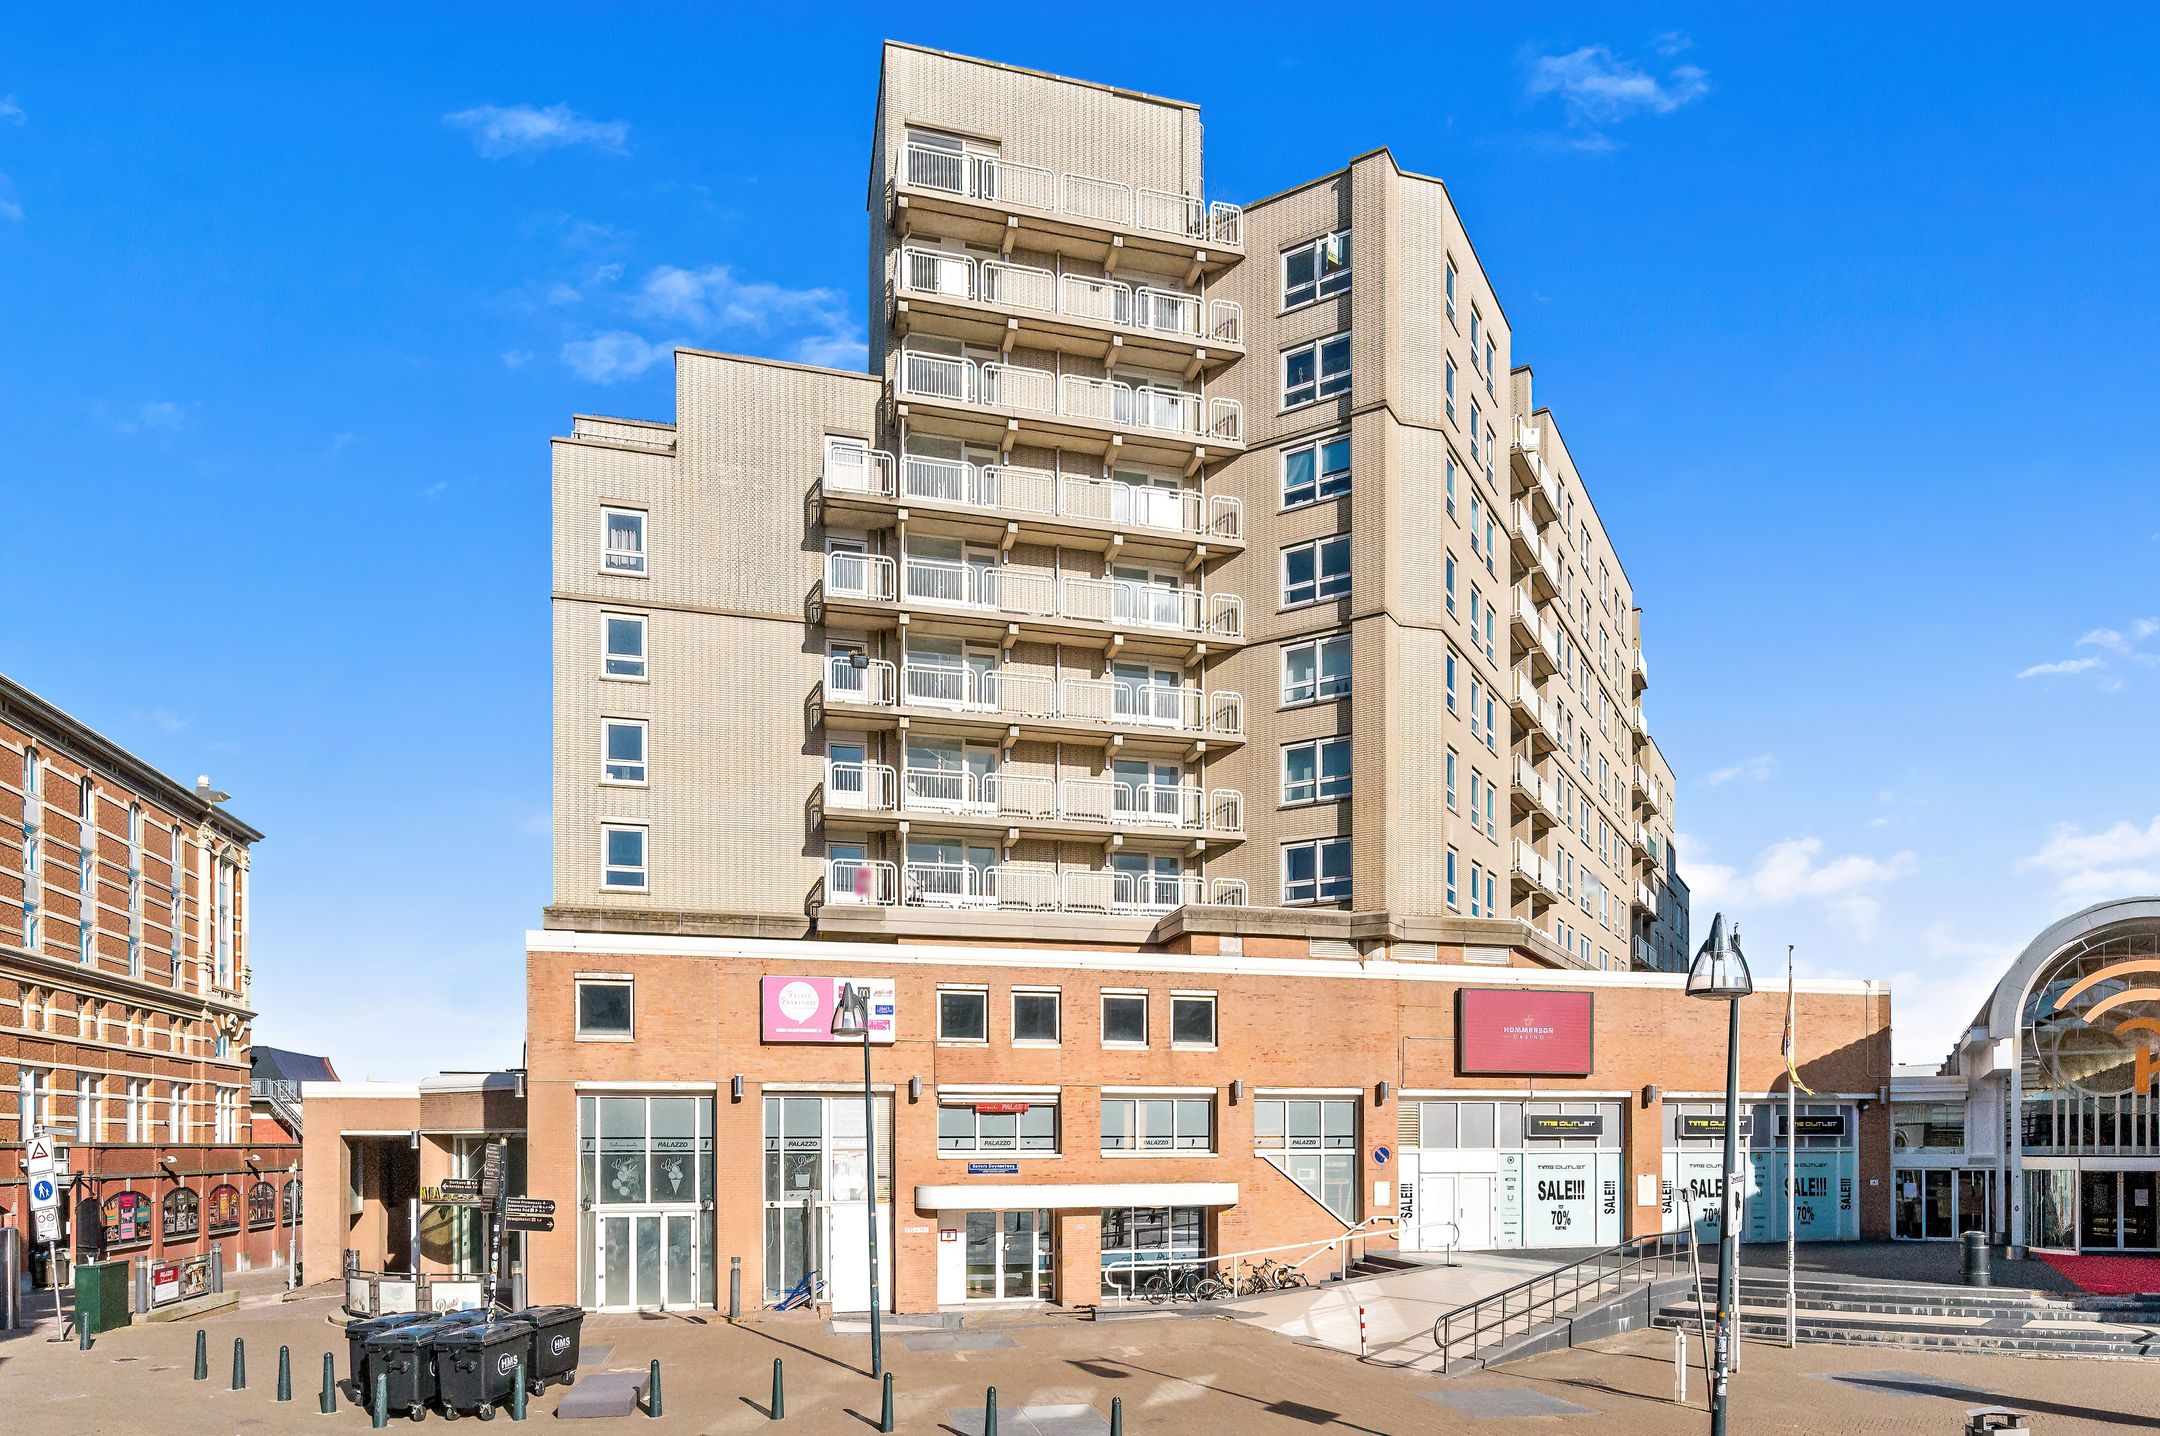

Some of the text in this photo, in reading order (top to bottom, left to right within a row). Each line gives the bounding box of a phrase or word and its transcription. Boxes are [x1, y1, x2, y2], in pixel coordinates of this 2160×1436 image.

[1538, 1179, 1585, 1201] SALE!!!
[1604, 1180, 1616, 1215] SALE!!!
[1841, 1178, 1851, 1211] SALE!!!
[1400, 1183, 1413, 1219] SALE!!!
[1551, 1210, 1571, 1226] 70%
[1796, 1206, 1815, 1221] 70%
[554, 1336, 571, 1350] HMS
[501, 1354, 518, 1369] HMS
